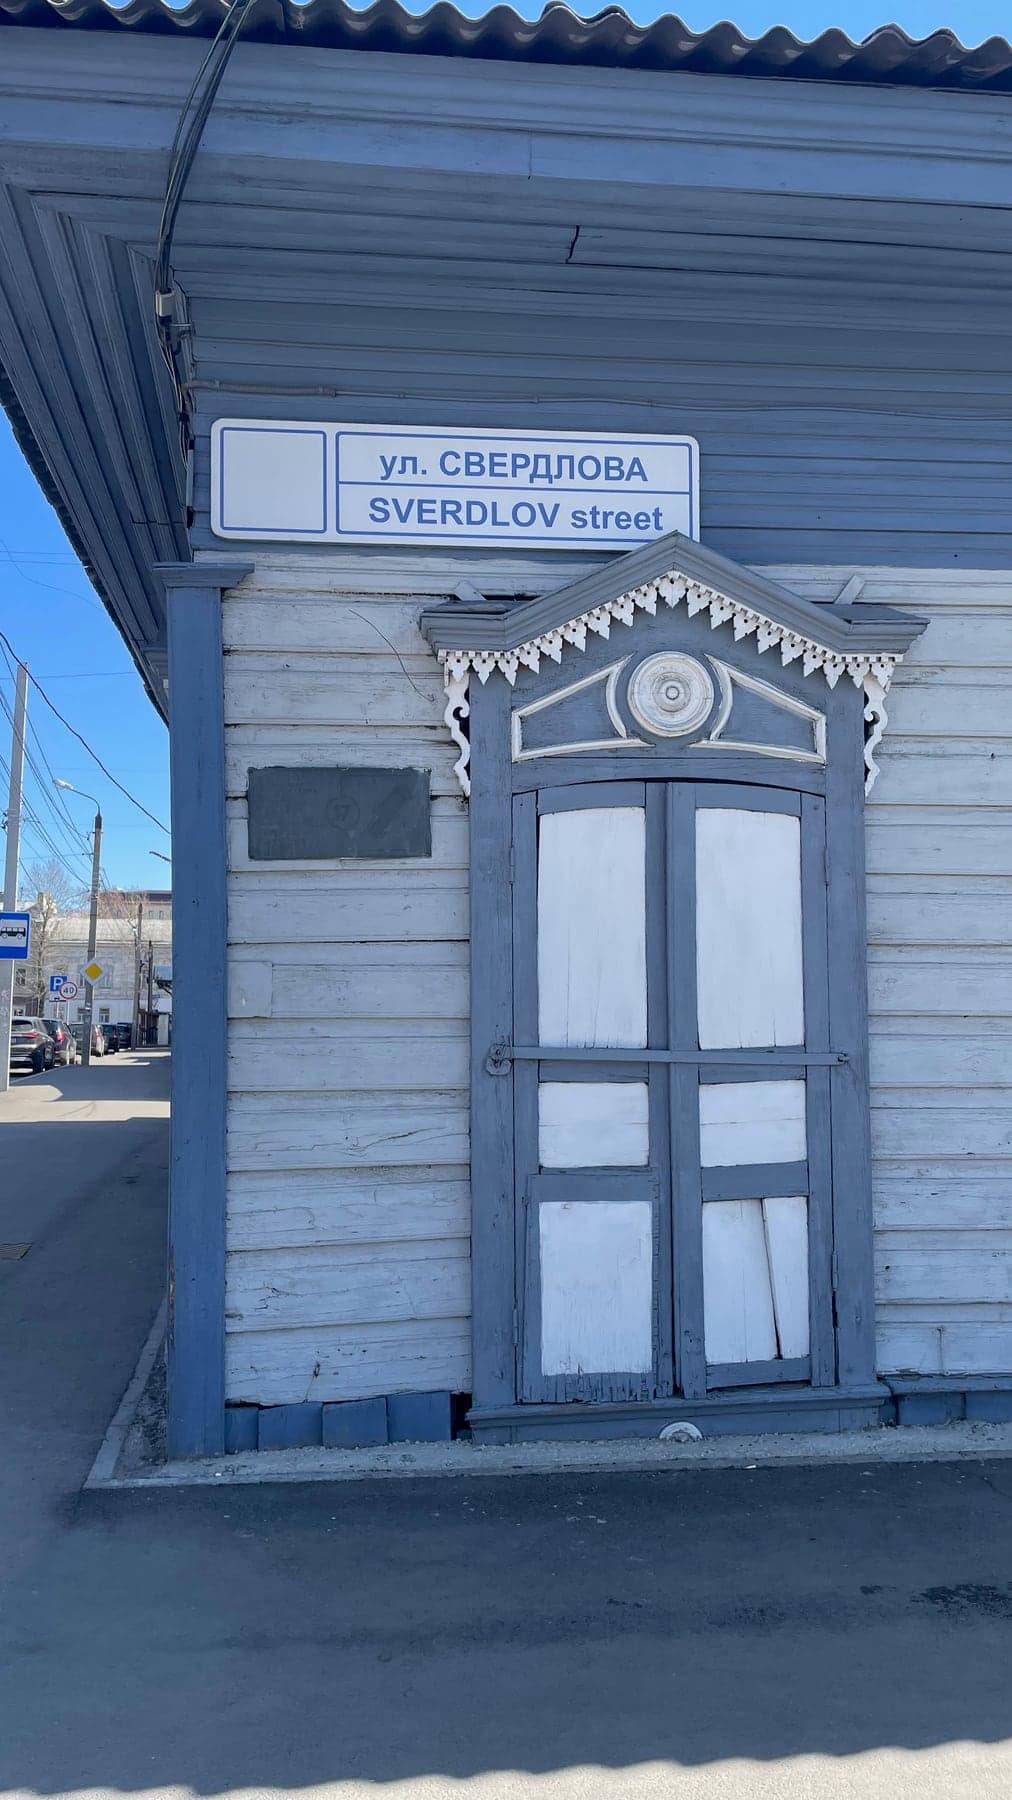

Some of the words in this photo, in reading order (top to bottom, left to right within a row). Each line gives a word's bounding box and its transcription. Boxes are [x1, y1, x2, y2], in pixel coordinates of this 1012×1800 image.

[379, 455, 427, 481] ул.
[439, 451, 648, 484] СВЕРДЛОВА
[368, 497, 560, 528] SVERDLOV
[570, 506, 663, 531] street
[53, 977, 64, 990] P
